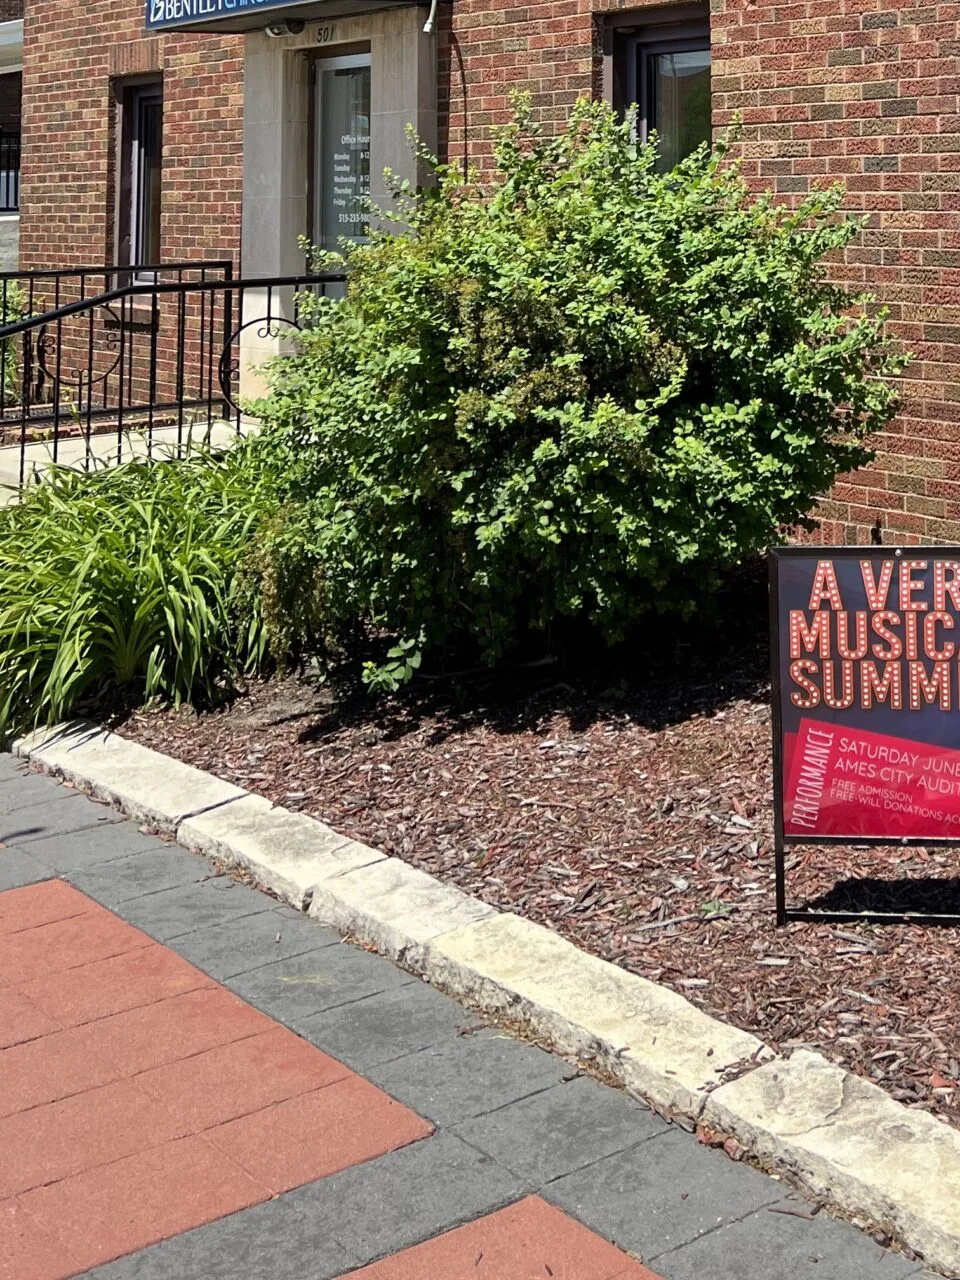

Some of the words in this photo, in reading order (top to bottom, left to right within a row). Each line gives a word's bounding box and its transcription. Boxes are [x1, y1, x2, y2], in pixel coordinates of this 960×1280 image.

[316, 26, 335, 43] 501
[341, 134, 356, 144] Office
[334, 153, 350, 161] Monday
[334, 164, 351, 173] Tuesday
[334, 175, 356, 184] Wednesday
[334, 186, 352, 195] Thursday
[333, 198, 346, 207] Friday
[808, 560, 842, 610] A
[838, 737, 919, 767] SATURDAY
[790, 727, 834, 829] PERFORMANCE
[834, 757, 877, 778] AMES
[880, 767, 914, 785] CITY
[831, 778, 857, 792] FREE
[858, 783, 913, 803] ADMISSION
[883, 800, 943, 821] DONATIONS
